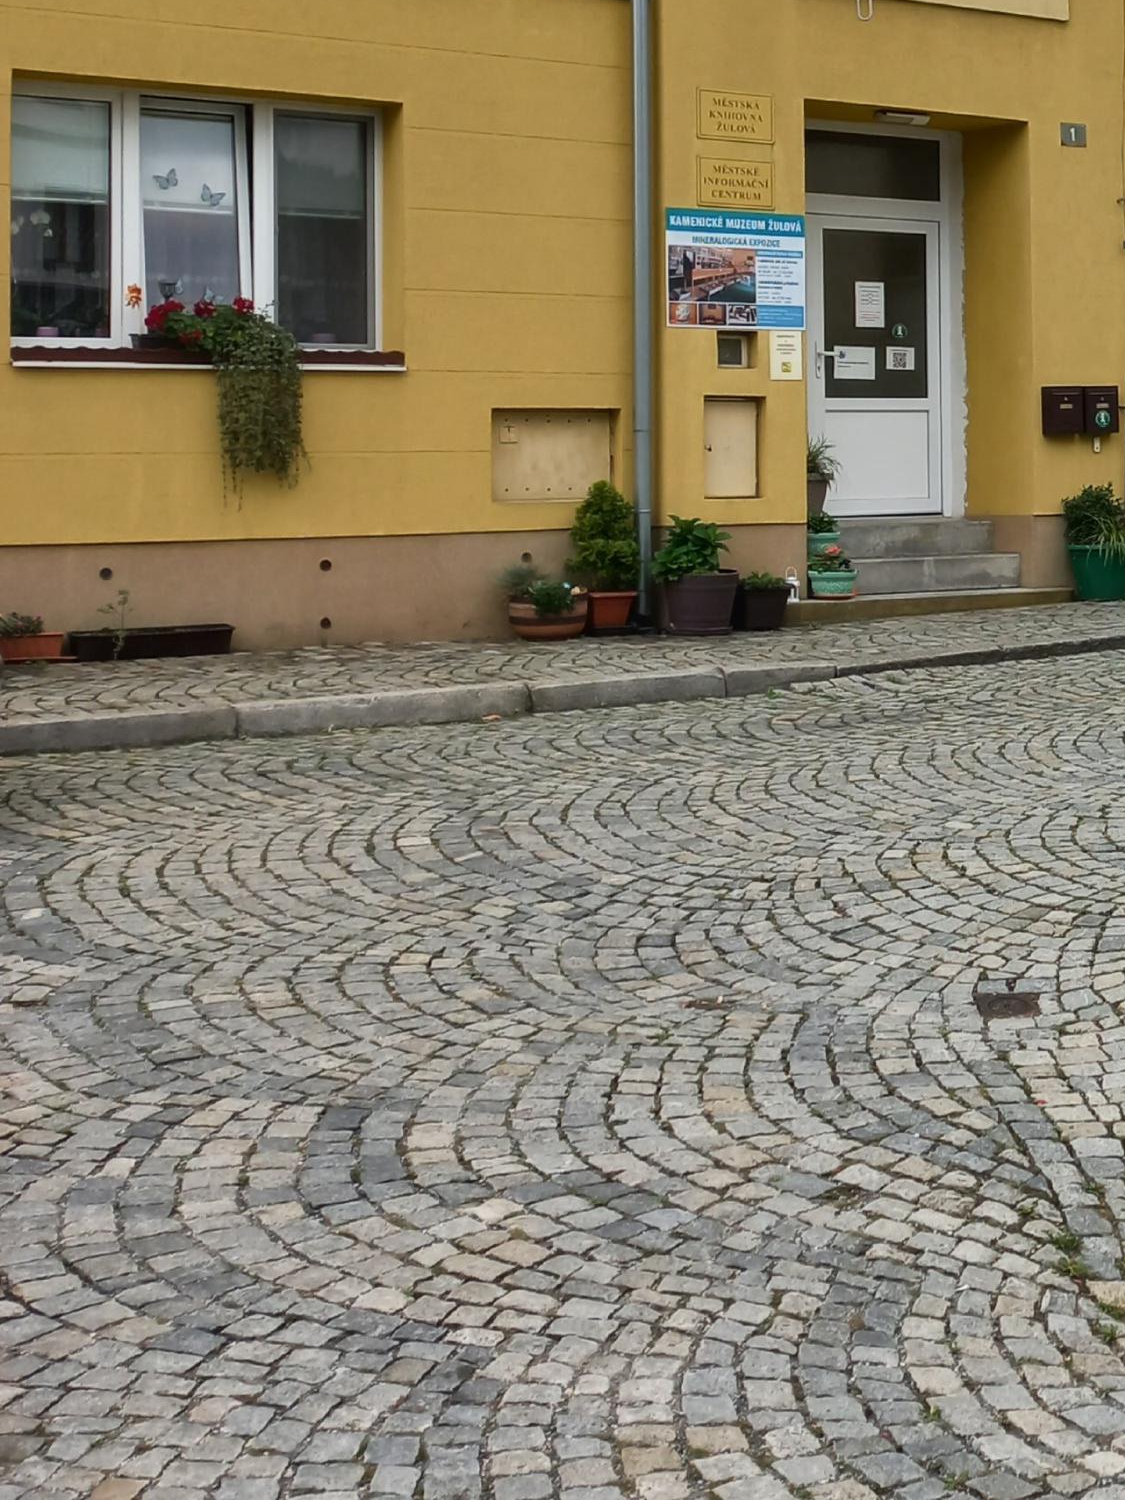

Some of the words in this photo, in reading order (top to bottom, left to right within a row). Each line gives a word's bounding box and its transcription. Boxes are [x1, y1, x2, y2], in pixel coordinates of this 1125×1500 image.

[709, 110, 763, 123] KNIHOVNA
[716, 121, 756, 134] ŽULOVÁ
[1069, 127, 1076, 142] 1
[703, 176, 769, 189] INFORMAČNÍ
[711, 189, 761, 201] CENTRUM
[669, 215, 723, 228] KAMENICKÉ
[725, 218, 766, 230] MUZEUM
[768, 219, 802, 233] ŽULOVÁ
